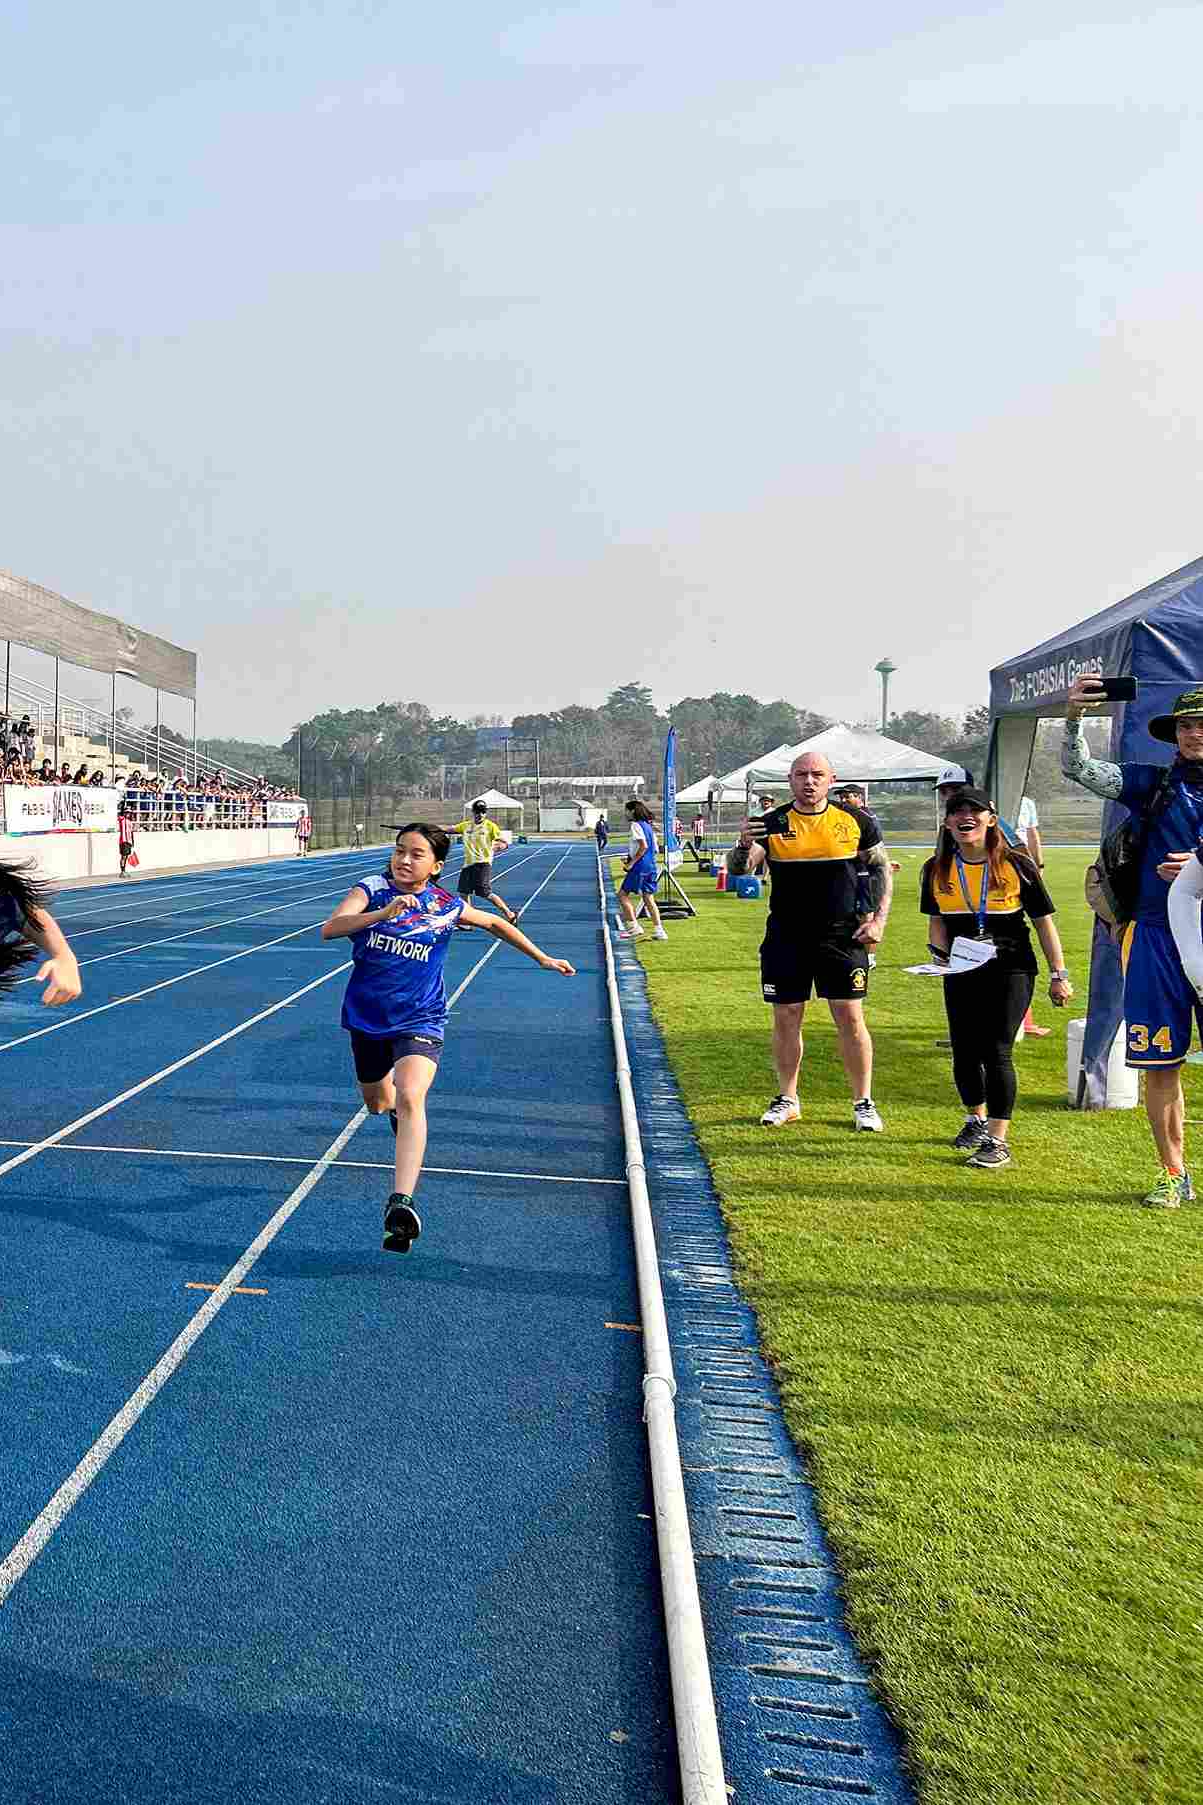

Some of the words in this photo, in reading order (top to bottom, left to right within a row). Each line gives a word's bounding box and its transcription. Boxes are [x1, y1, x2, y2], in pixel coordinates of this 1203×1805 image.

[1026, 662, 1066, 698] FOBISIA
[366, 930, 434, 963] NETWORK
[1128, 1023, 1173, 1053] 34
